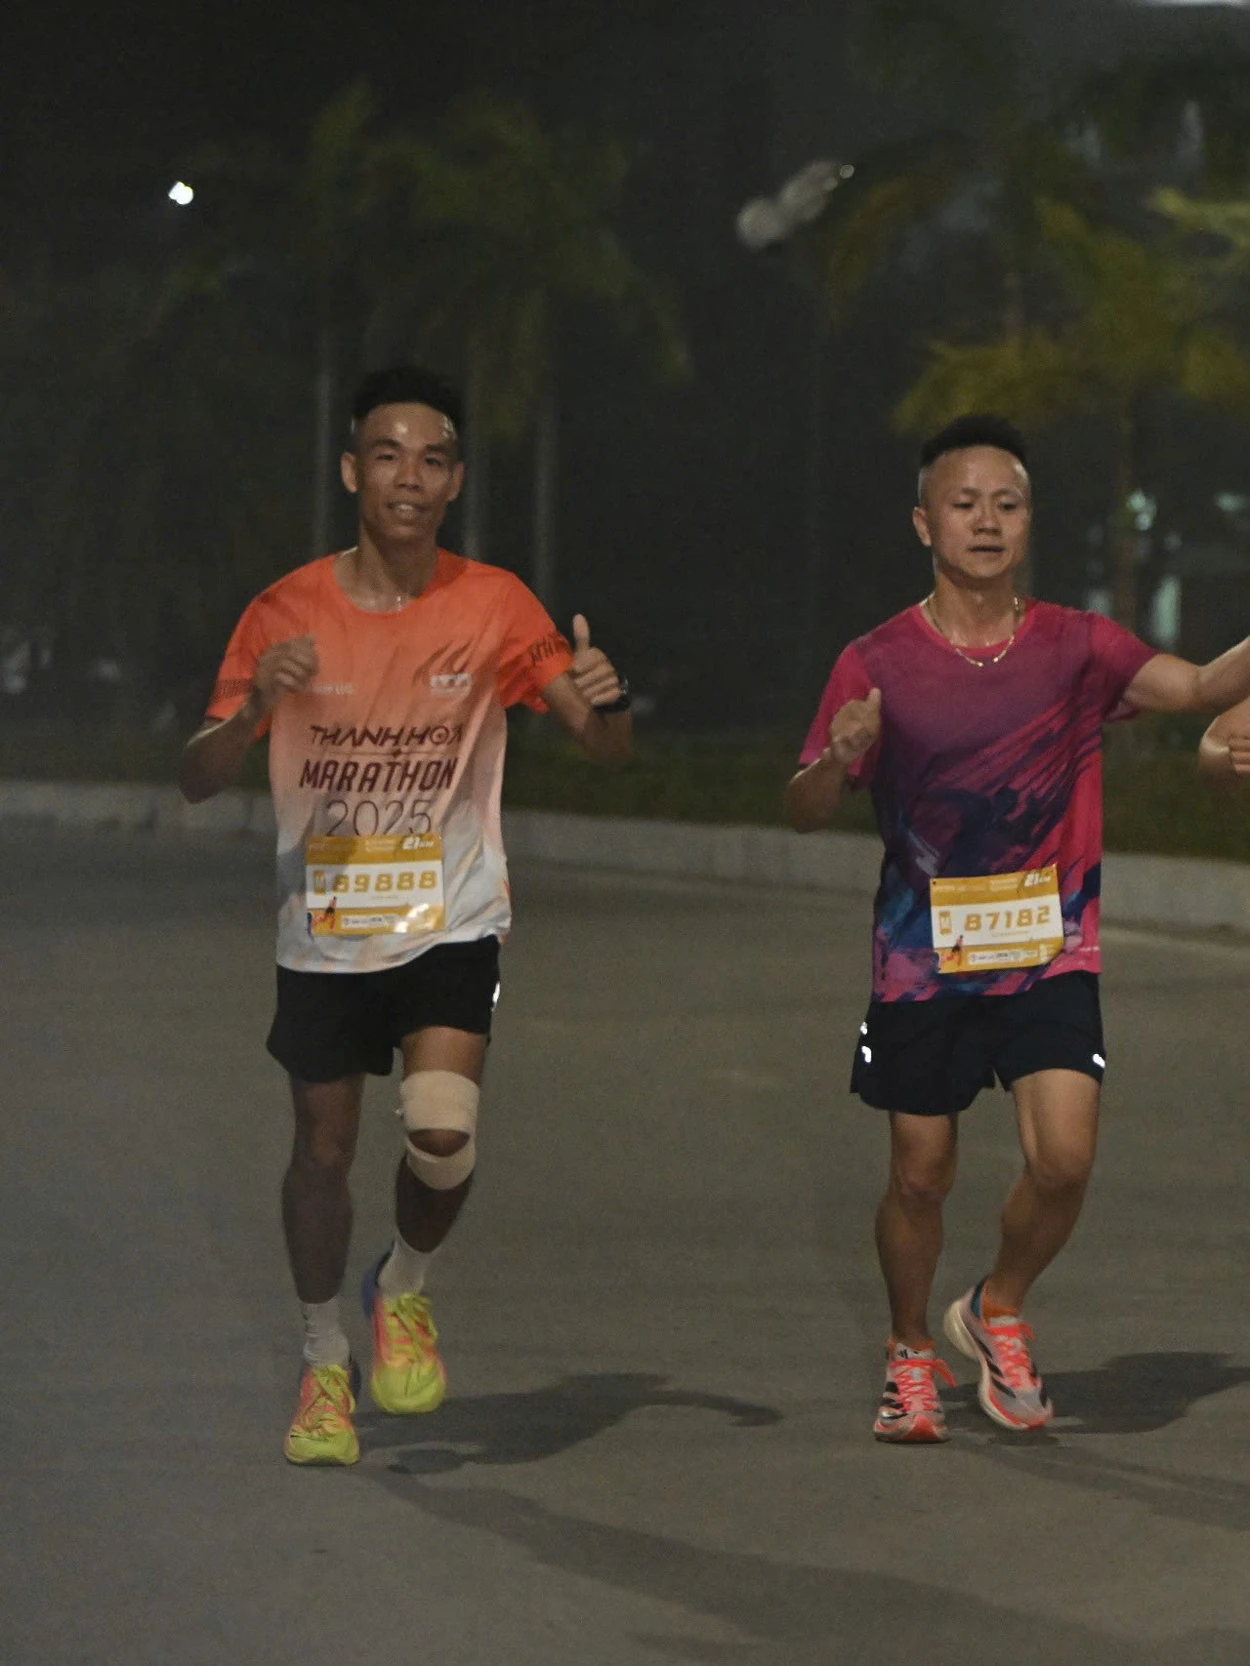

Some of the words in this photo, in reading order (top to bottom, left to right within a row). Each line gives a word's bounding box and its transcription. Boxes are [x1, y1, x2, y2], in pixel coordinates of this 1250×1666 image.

[310, 725, 404, 747] THANH
[299, 758, 458, 793] MARATHON
[325, 800, 432, 836] 2025
[332, 870, 437, 893] 89888
[964, 905, 1050, 932] 87182
